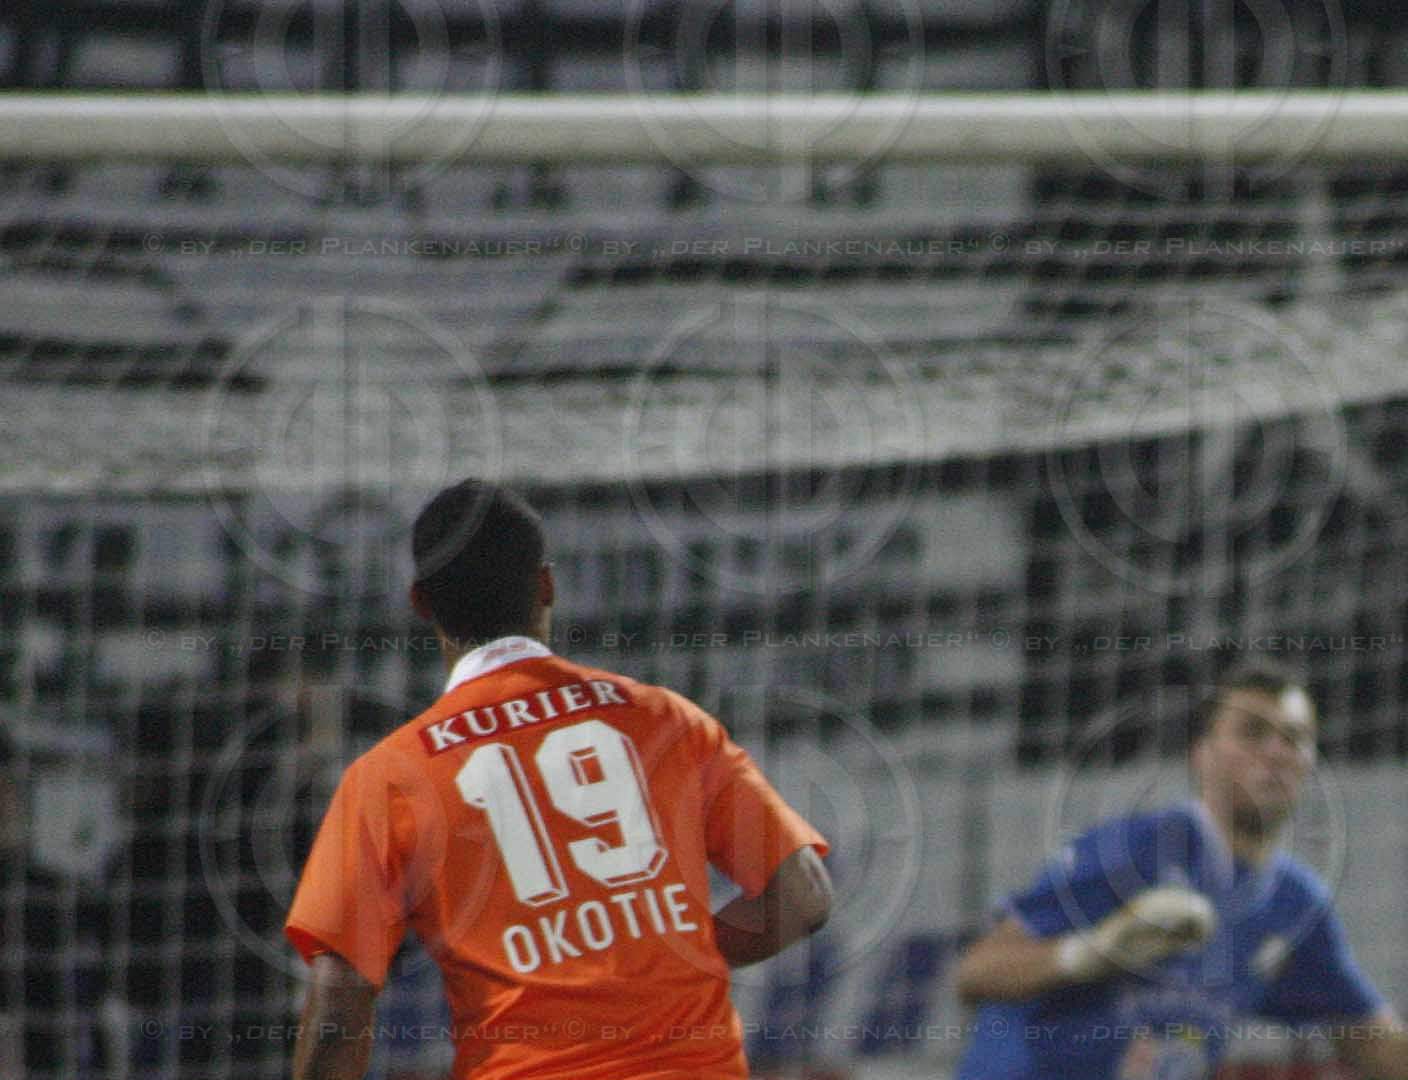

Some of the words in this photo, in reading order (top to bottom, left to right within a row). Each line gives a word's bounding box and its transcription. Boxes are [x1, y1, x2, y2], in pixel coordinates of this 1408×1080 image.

[426, 680, 628, 750] KURIER
[455, 719, 669, 908] 19
[502, 883, 698, 975] OKOTIE
